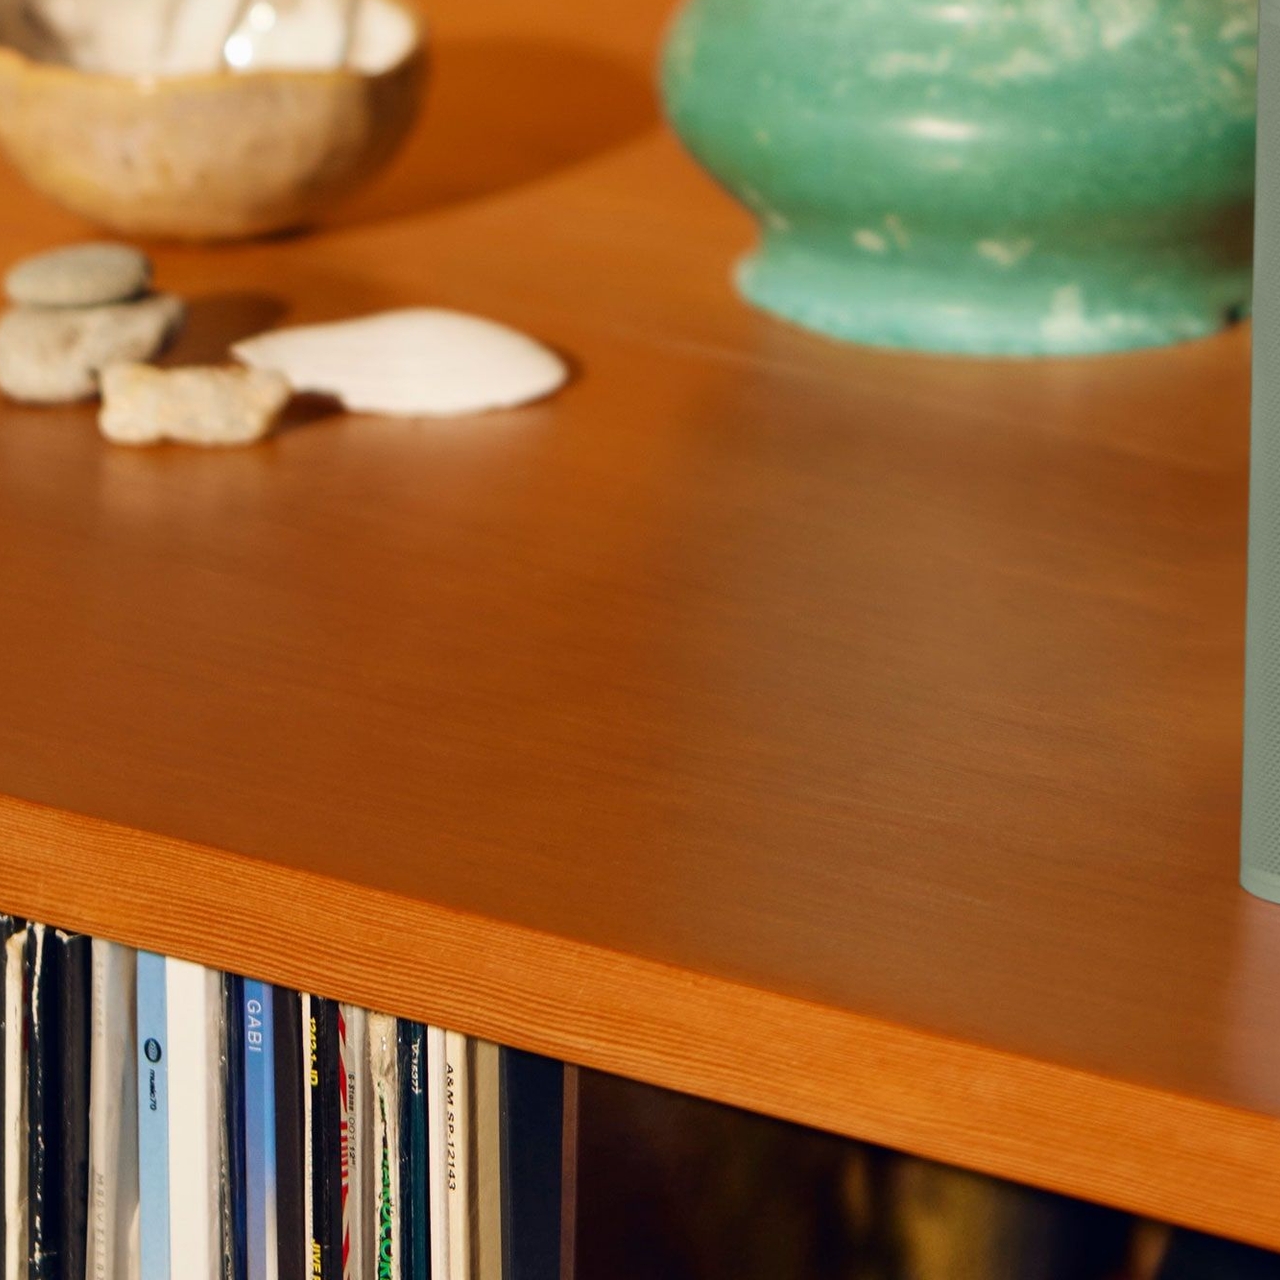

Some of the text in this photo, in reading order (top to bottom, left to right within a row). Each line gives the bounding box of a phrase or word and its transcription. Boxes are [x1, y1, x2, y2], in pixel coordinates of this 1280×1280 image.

[246, 999, 262, 1052] GABI
[446, 1062, 456, 1191] A&M SP-12143
